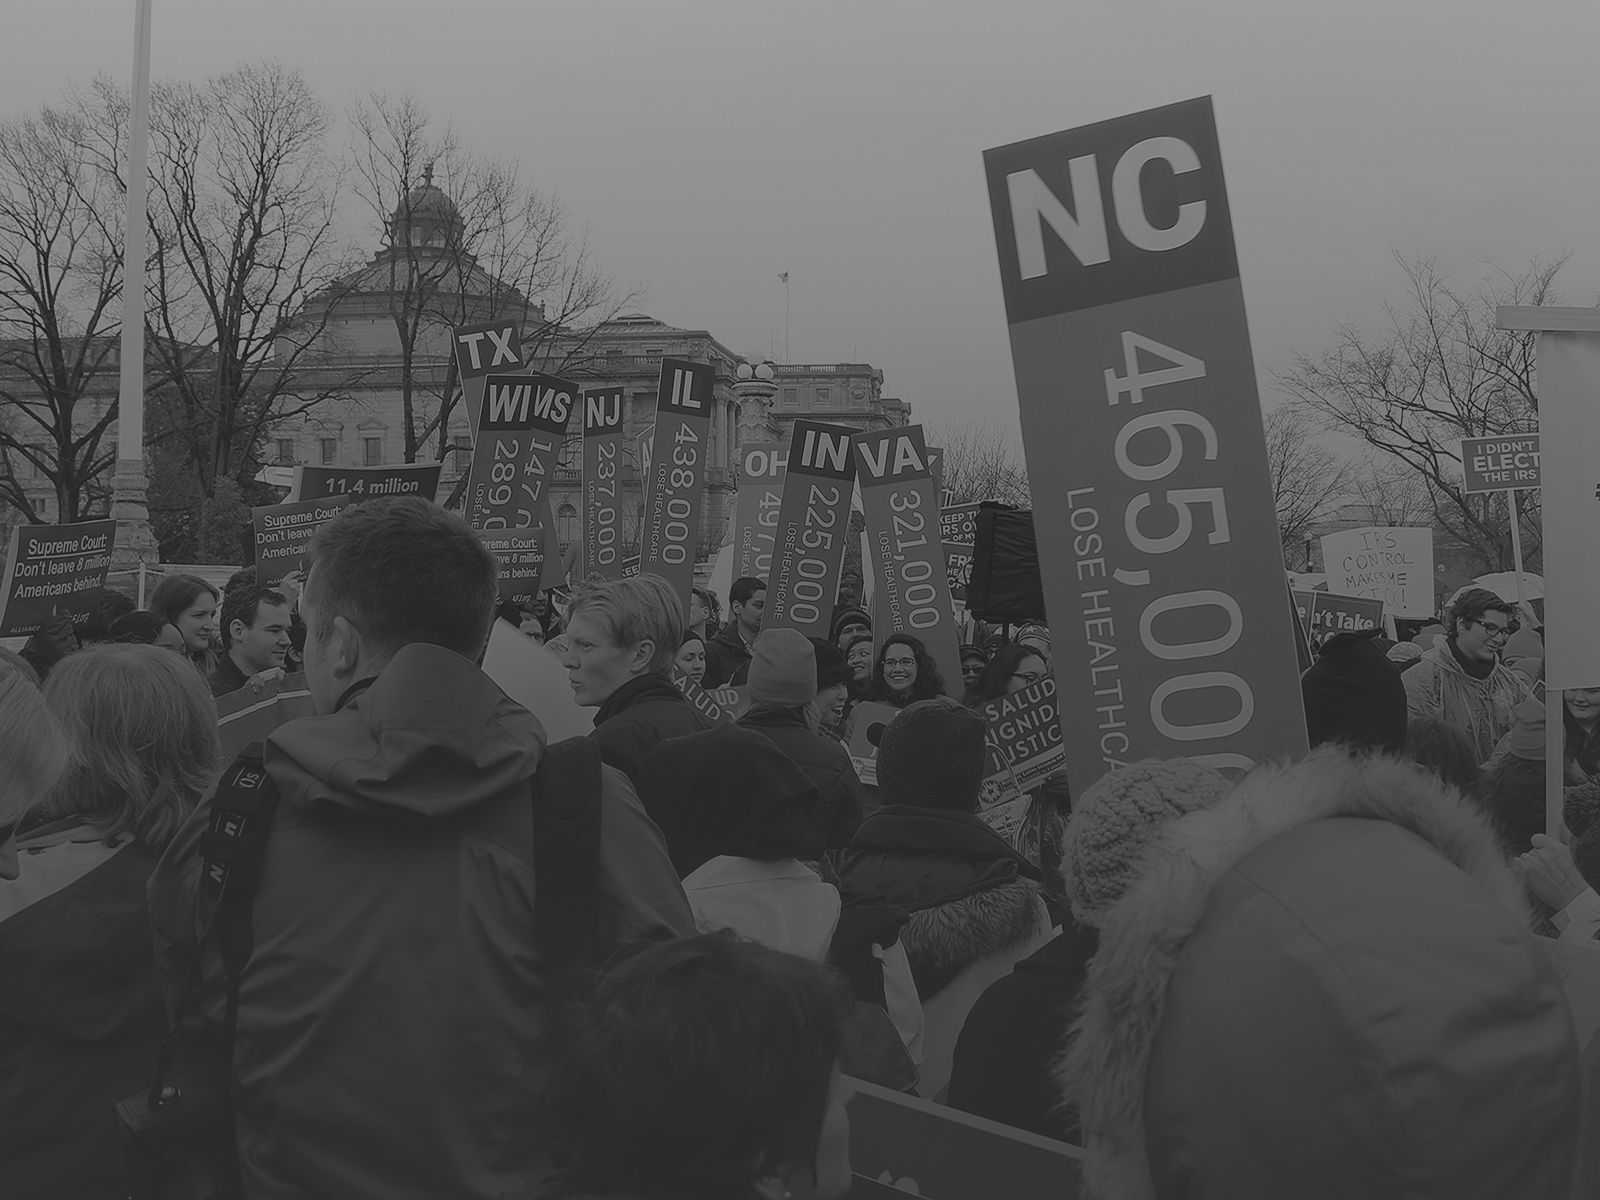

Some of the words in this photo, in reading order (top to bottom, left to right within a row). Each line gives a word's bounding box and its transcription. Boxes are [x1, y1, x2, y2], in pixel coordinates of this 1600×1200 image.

[1006, 136, 1207, 281] NC
[458, 327, 520, 370] TX
[671, 368, 701, 409] IL
[587, 394, 621, 428] NJ
[801, 430, 850, 472] IN
[857, 435, 925, 478] VA
[1473, 451, 1541, 473] ELECT
[1477, 444, 1482, 455] I
[1485, 441, 1535, 455] DIDN'T
[325, 478, 364, 494] 11.4
[369, 478, 419, 494] million
[657, 462, 668, 492] LOSE
[1482, 470, 1511, 483] THE
[1514, 469, 1537, 480] IRS
[474, 482, 486, 511] LOSE
[595, 442, 616, 565] 237,000
[662, 422, 699, 565] 438,000
[264, 511, 313, 527] Supreme
[649, 492, 663, 563] HEALTHCARE
[1066, 486, 1107, 581] LOSE
[28, 539, 79, 557] Supreme
[80, 533, 108, 551] Court:
[256, 528, 286, 545] Don't
[287, 525, 313, 540] leave
[511, 537, 538, 549] Court:
[588, 506, 597, 568] HEALTHCARE
[743, 526, 752, 548] LOSE
[785, 521, 798, 549] LOSE
[878, 530, 890, 560] LOSE
[1360, 531, 1397, 551] IRS
[15, 561, 47, 578] Don't
[48, 560, 75, 576] leave
[76, 557, 84, 571] 8
[84, 554, 112, 571] million
[512, 552, 518, 564] 8
[519, 552, 544, 564] million
[789, 484, 840, 625] 225,000
[889, 489, 941, 629] 321,000
[1343, 551, 1413, 573] CONTROL
[14, 582, 73, 599] Americans
[73, 574, 102, 593] behind.
[512, 567, 539, 579] behind.
[772, 549, 793, 620] HEALTHCARE
[882, 560, 904, 632] HEALTHCARE
[1336, 611, 1375, 631] Take
[673, 664, 721, 721] ALUD
[1080, 588, 1131, 771] HEALTHCA
[985, 678, 1056, 722] SALUD
